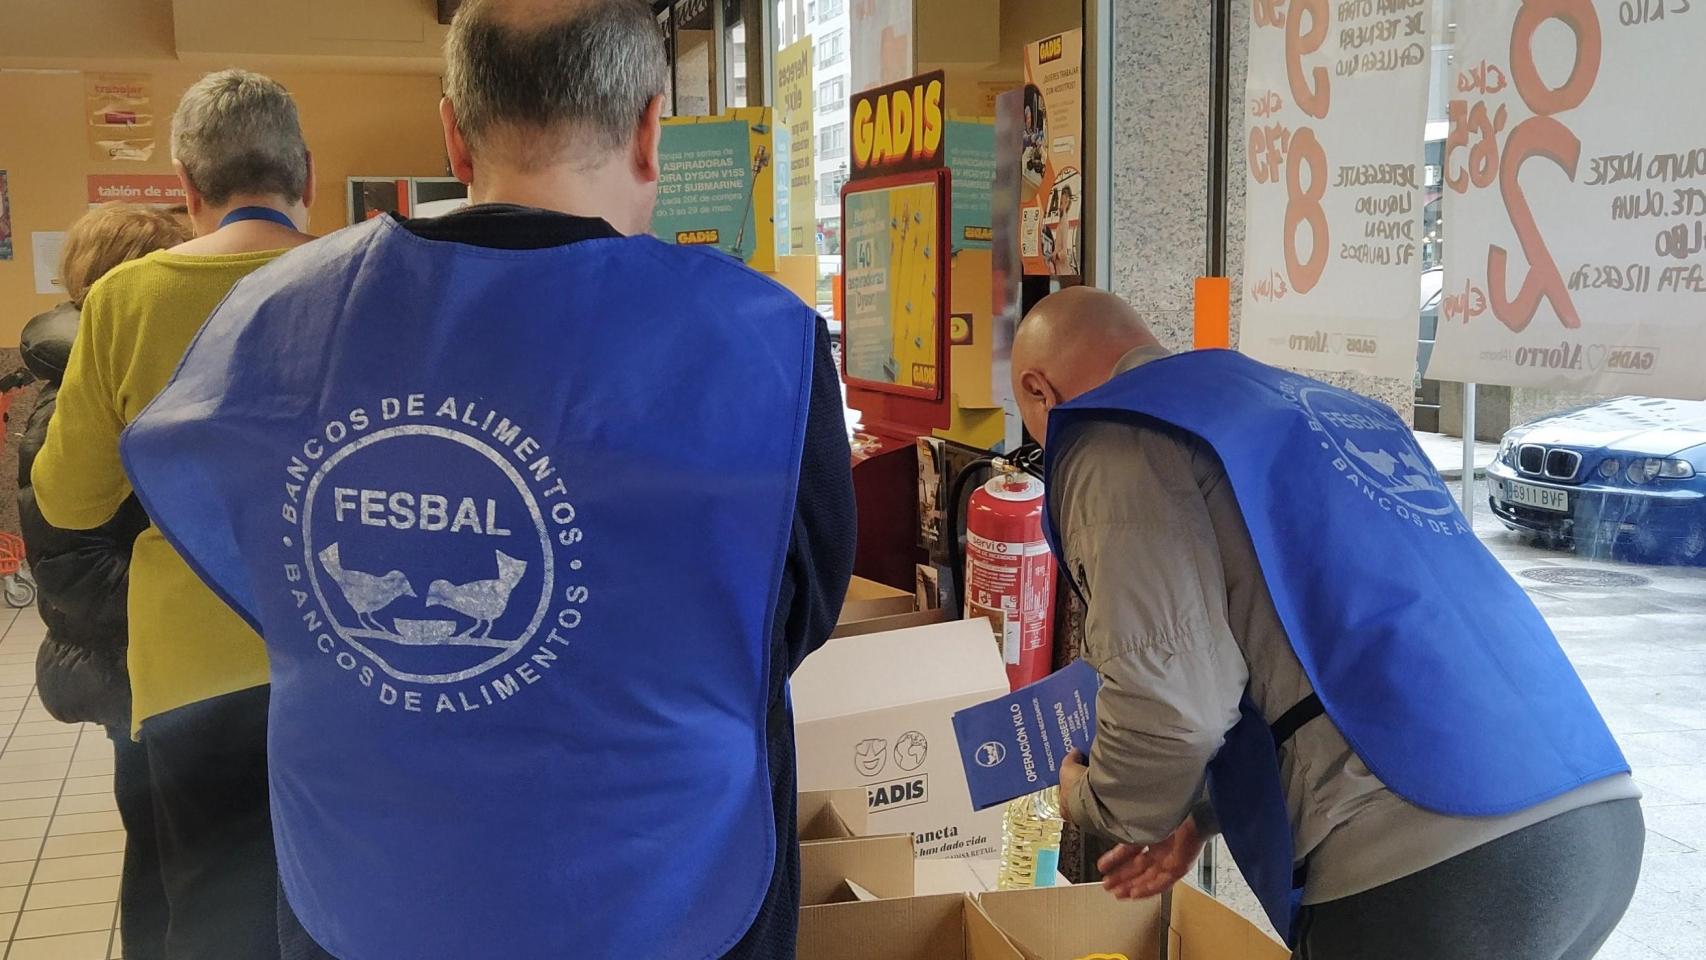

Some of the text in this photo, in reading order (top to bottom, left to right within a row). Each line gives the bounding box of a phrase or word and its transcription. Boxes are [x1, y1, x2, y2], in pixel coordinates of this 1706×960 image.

[1040, 36, 1062, 60] GADIS
[852, 79, 942, 168] GADIS
[663, 158, 734, 171] ASPIRADORAS
[685, 170, 719, 181] DYSON
[98, 184, 140, 197] tablón
[144, 184, 161, 197] de
[685, 180, 744, 193] SUBMARINE
[678, 231, 718, 244] GADIS
[912, 365, 936, 386] GADIS
[1320, 411, 1398, 432] FESBAL
[281, 393, 584, 547] BANCOS DE ALIMENTOS
[1332, 456, 1424, 528] BANCOS
[1427, 518, 1453, 536] DE
[1541, 490, 1564, 508] BVF
[333, 486, 512, 538] FESBAL
[283, 563, 590, 713] BANCOS DE ALIMENTOS
[1054, 702, 1074, 753] CONSERVAS
[1010, 703, 1038, 782] OPERACIÓN KILO
[919, 835, 987, 857] han dado vida
